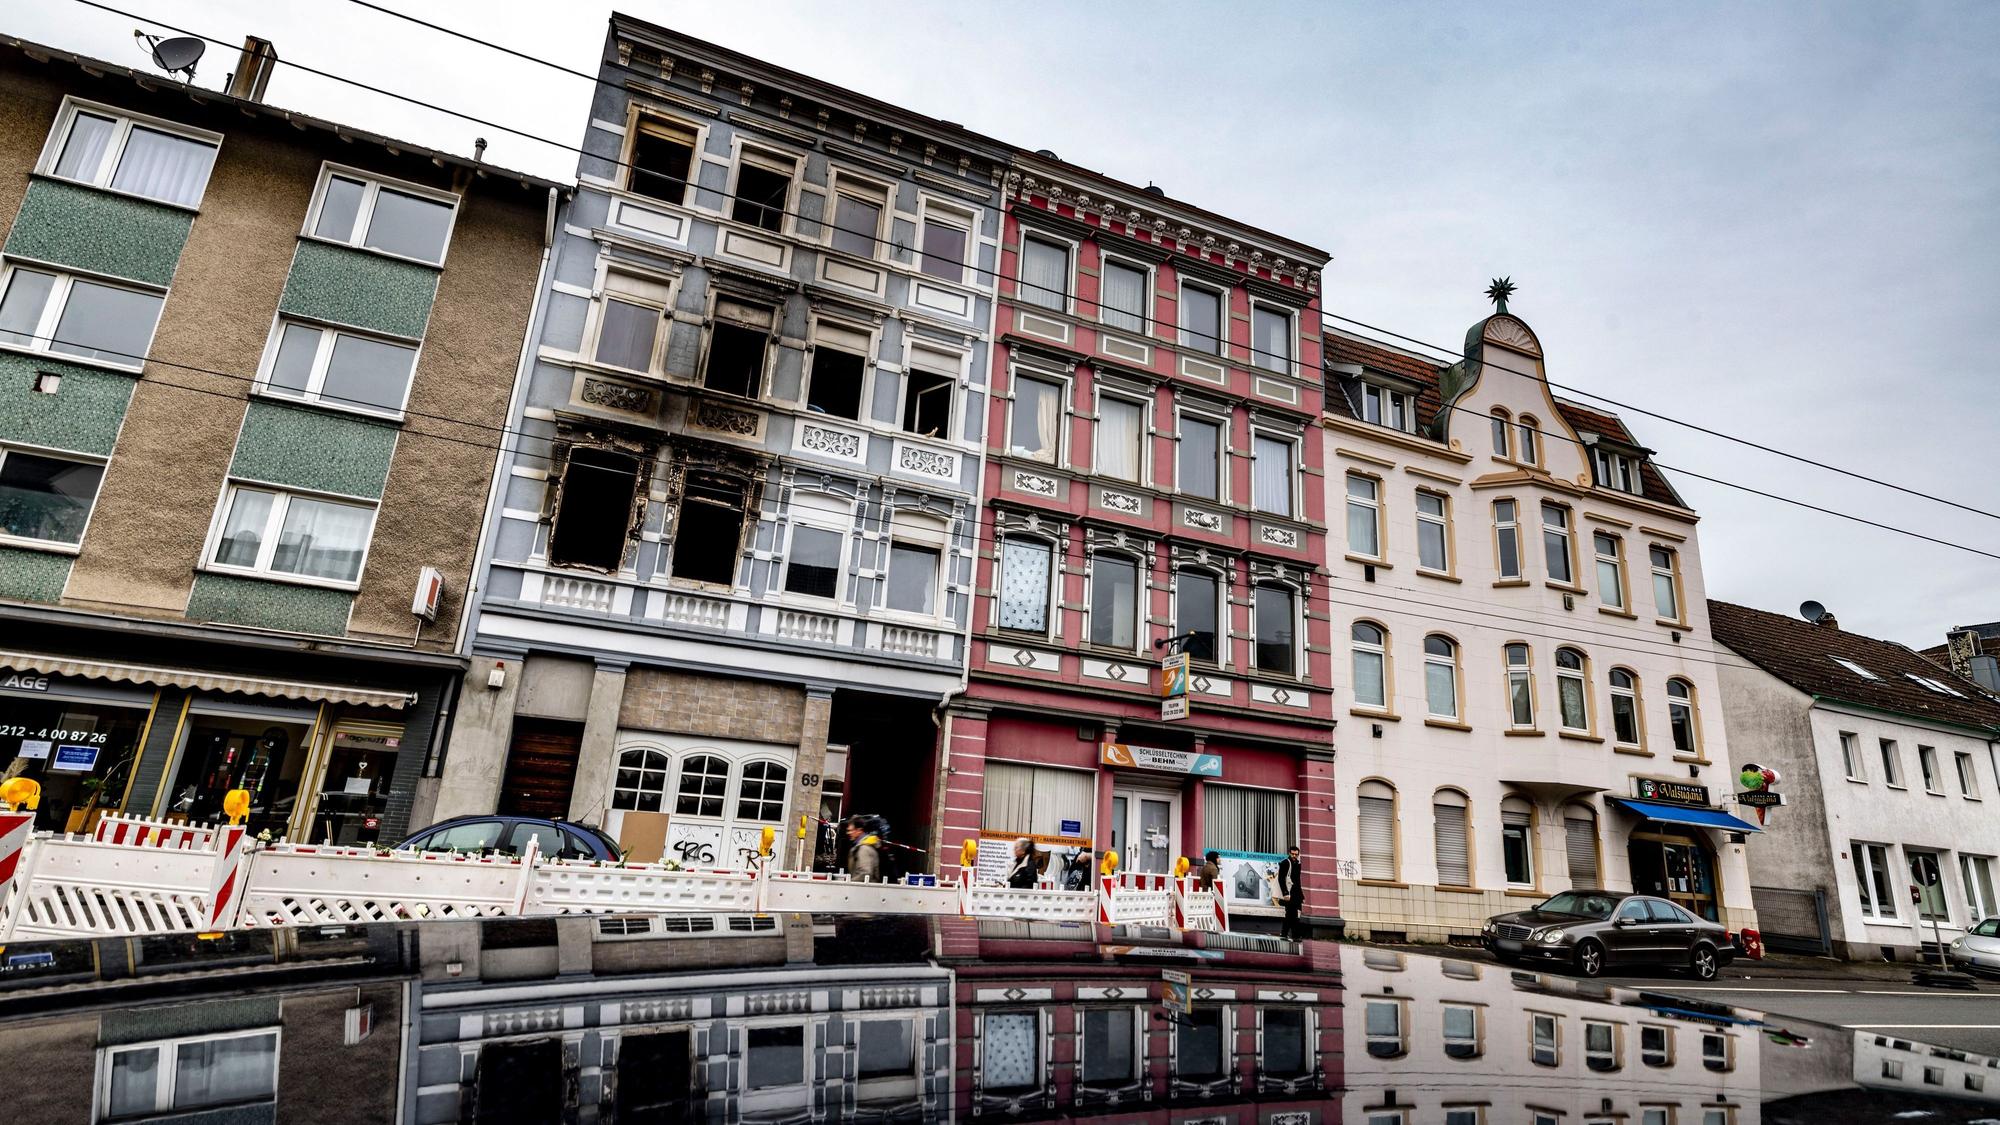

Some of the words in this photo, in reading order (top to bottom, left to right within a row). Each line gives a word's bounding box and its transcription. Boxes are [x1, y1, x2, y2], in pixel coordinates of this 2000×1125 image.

[5, 675, 48, 690] AGE
[0, 725, 26, 737] 212
[38, 728, 47, 738] 4
[50, 729, 68, 740] 00
[70, 731, 88, 742] 87
[90, 733, 108, 743] 26
[1139, 748, 1188, 760] SCHLÜSSELTECHNIK
[1152, 757, 1176, 765] BEHM
[802, 773, 819, 787] 69
